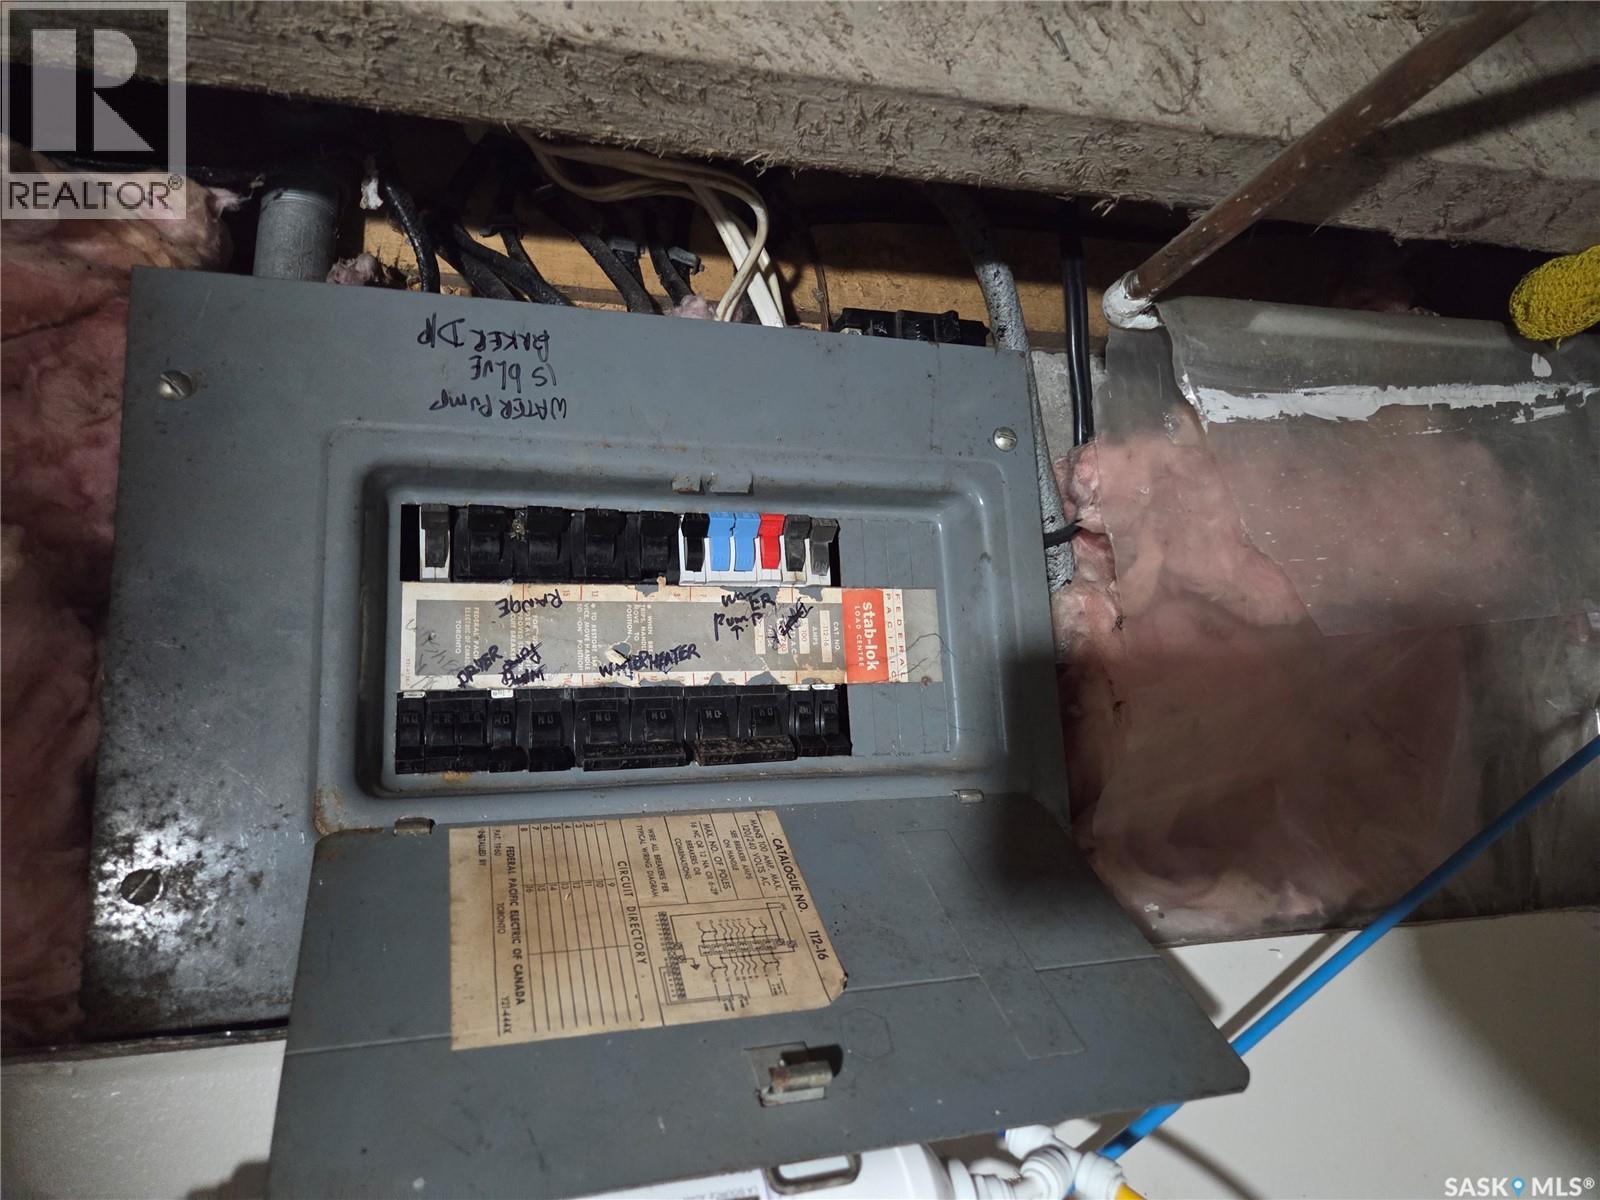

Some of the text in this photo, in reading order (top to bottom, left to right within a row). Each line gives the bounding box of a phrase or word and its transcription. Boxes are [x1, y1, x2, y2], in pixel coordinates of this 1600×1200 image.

[500, 397, 567, 421] WATER
[856, 634, 865, 667] CENTRE
[862, 602, 877, 671] stab-lok
[886, 593, 897, 678] PACIFIC
[895, 593, 907, 679] FEDERAL
[651, 843, 659, 853] ALL
[709, 840, 719, 854] NO.
[751, 819, 763, 839] MAINS
[758, 841, 769, 853] 100
[636, 824, 659, 897] TYPICAL WIRING DIAGRAM
[654, 854, 666, 880] BREAKERS
[674, 837, 692, 880] COMBINATIONS
[685, 840, 702, 876] BREAKERS OR
[696, 840, 705, 849] OR
[705, 870, 714, 880] OR
[713, 856, 724, 866] OF
[723, 839, 740, 871] ON HANDLE
[730, 829, 754, 880] SEE BREAKER AMPS
[741, 824, 771, 887] 120/240 VOLTS AC
[661, 881, 670, 894] PER
[717, 868, 732, 890] POLES
[617, 860, 647, 965] CIRCUIT DIRECTORY
[772, 838, 802, 892] CATALOGUE
[794, 893, 809, 913] NO.
[808, 929, 829, 961] 112-16
[497, 902, 506, 935] TORONTO
[506, 846, 526, 1006] FEDERAL PACIFIC ELECTRIC OF CANADA
